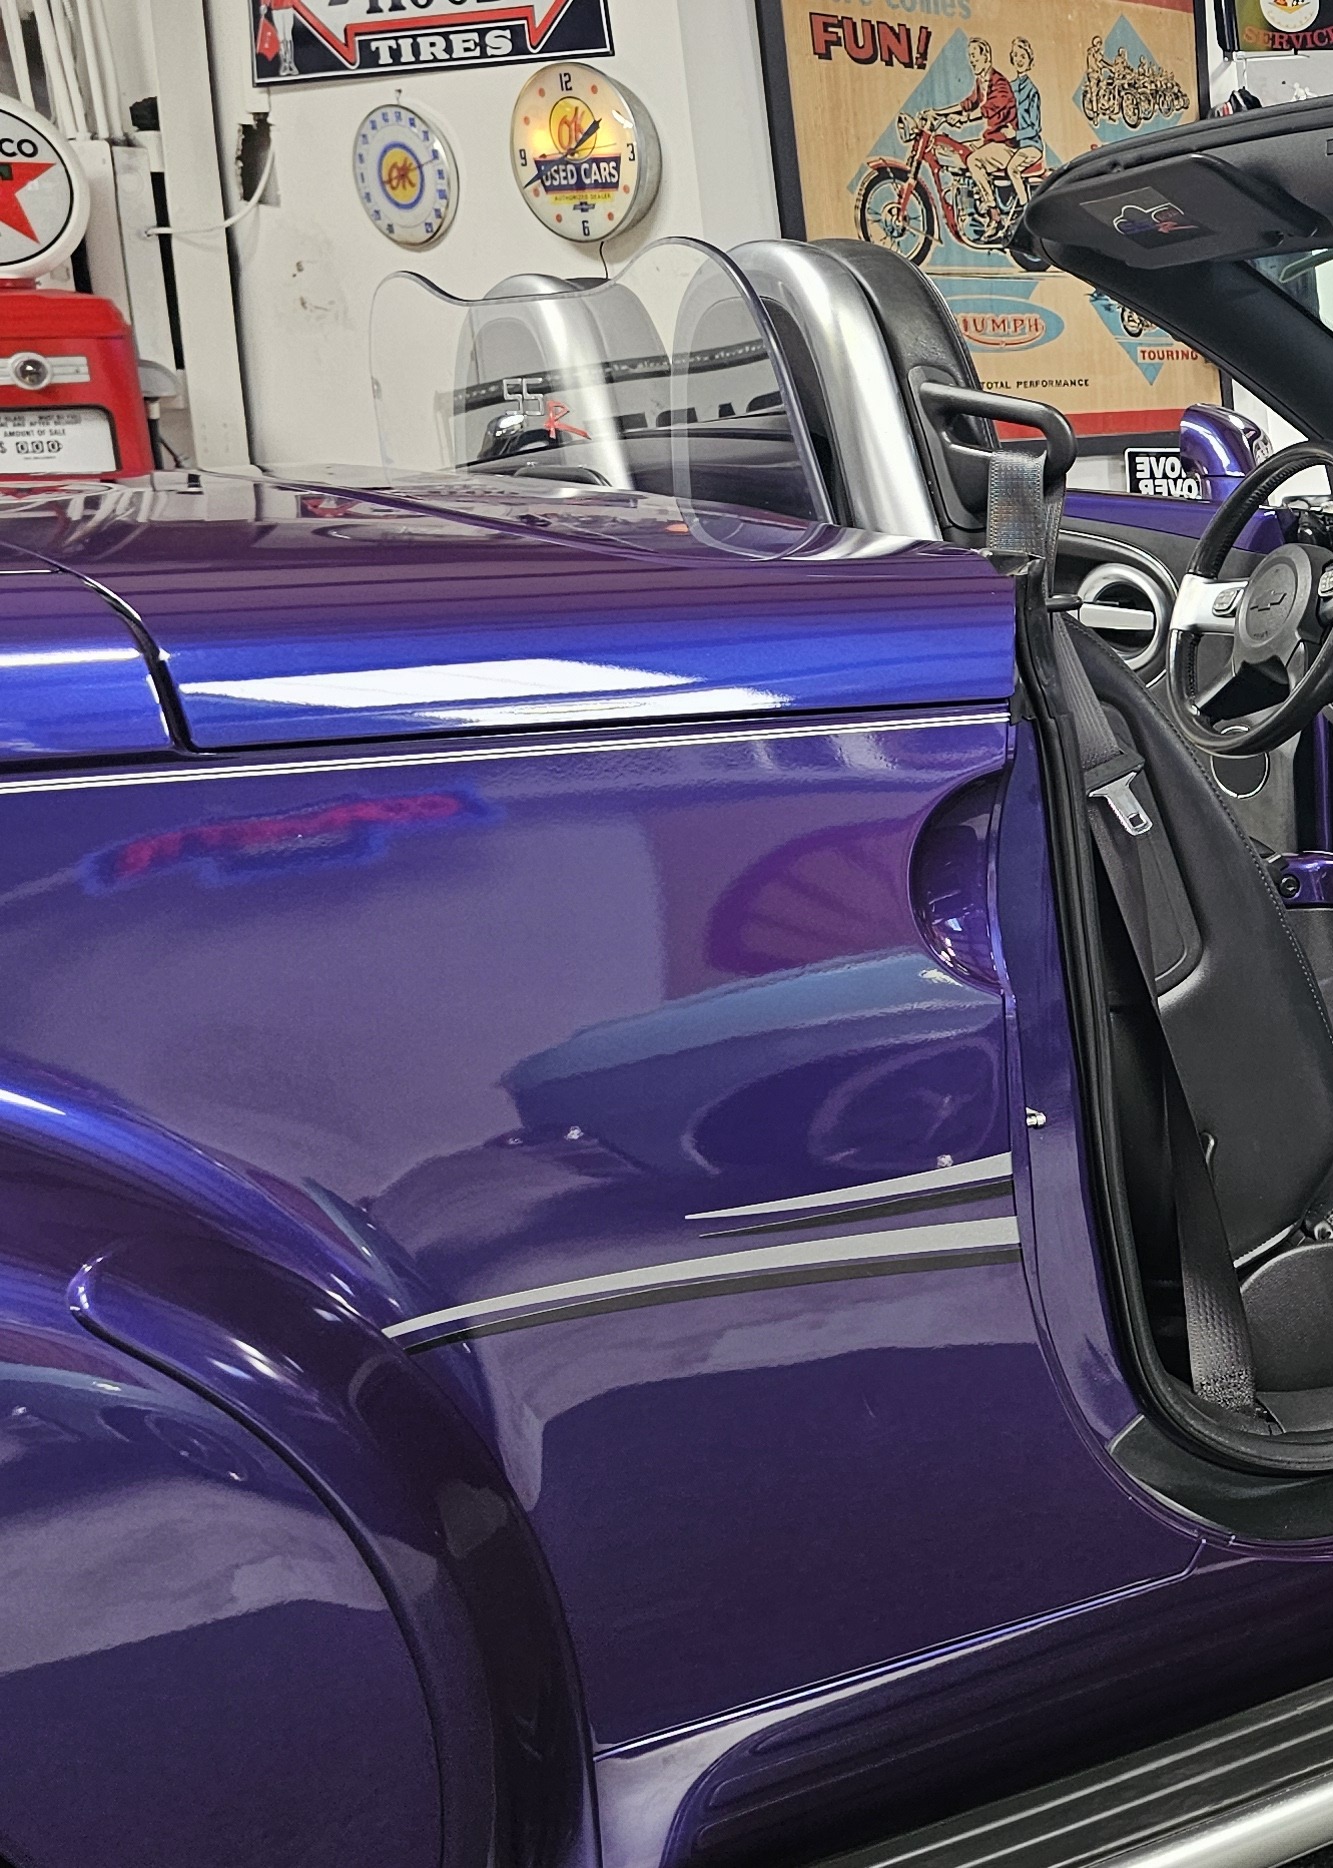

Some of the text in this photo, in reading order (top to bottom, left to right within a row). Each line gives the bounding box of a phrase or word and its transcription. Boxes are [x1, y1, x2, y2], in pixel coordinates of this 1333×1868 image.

[370, 29, 514, 65] TIRES
[809, 12, 932, 70] FUN!
[559, 72, 572, 92] 12
[519, 148, 528, 167] 9
[626, 143, 636, 162] 3
[542, 162, 618, 187] USED CARS
[582, 220, 590, 237] 6
[1140, 350, 1198, 361] TOURING
[981, 378, 1090, 390] TOTAL PERFORMANCE
